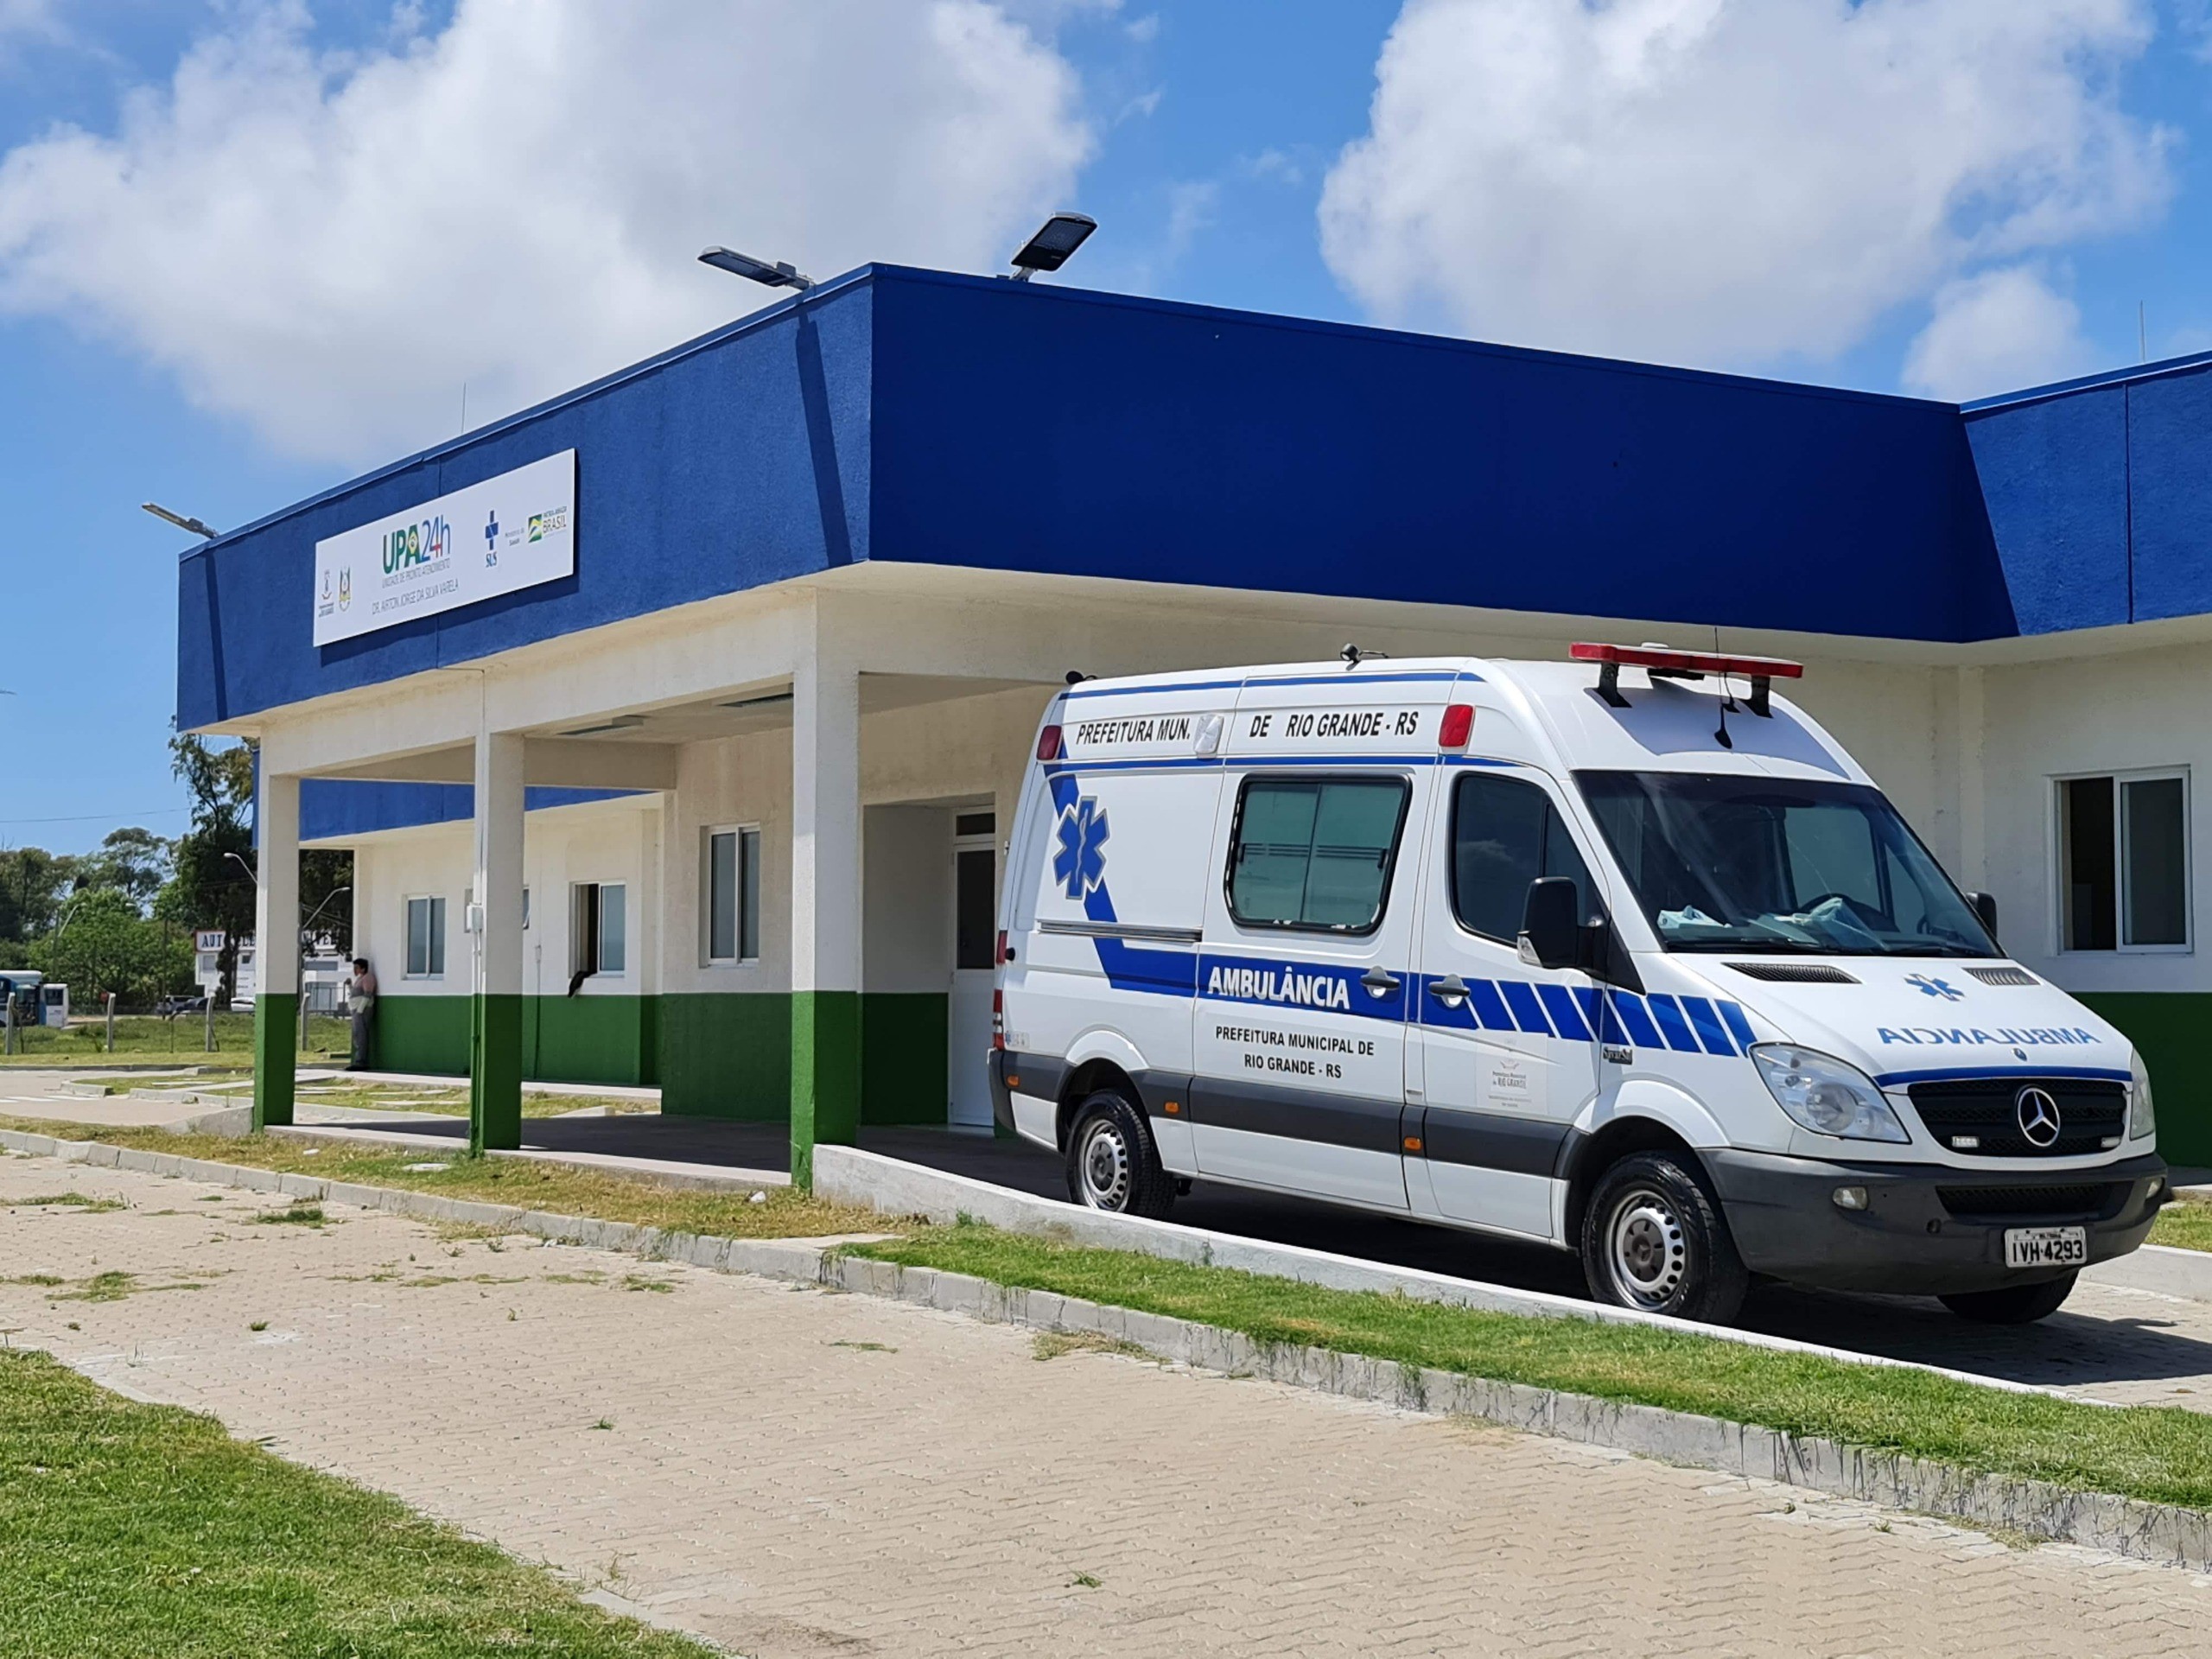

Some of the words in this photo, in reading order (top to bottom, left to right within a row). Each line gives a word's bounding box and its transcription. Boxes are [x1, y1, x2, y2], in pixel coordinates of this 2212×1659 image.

[543, 515, 567, 533] BRASIL
[486, 551, 498, 568] SUS
[1076, 720, 1154, 745] PREFEITURA
[1156, 718, 1191, 741] MUN.
[1249, 715, 1272, 738] DE
[1286, 714, 1313, 737] RIO
[1317, 713, 1384, 737] GRANDE
[1395, 711, 1419, 735] RS
[1207, 966, 1350, 1009] AMBULÂNCIA
[1216, 1026, 1285, 1046] PREFEITURA
[1288, 1033, 1354, 1053] MUNICIPAL
[1358, 1041, 1375, 1056] DE
[1244, 1054, 1263, 1069] RIO
[1268, 1057, 1315, 1075] GRANDE
[1326, 1064, 1342, 1078] RS
